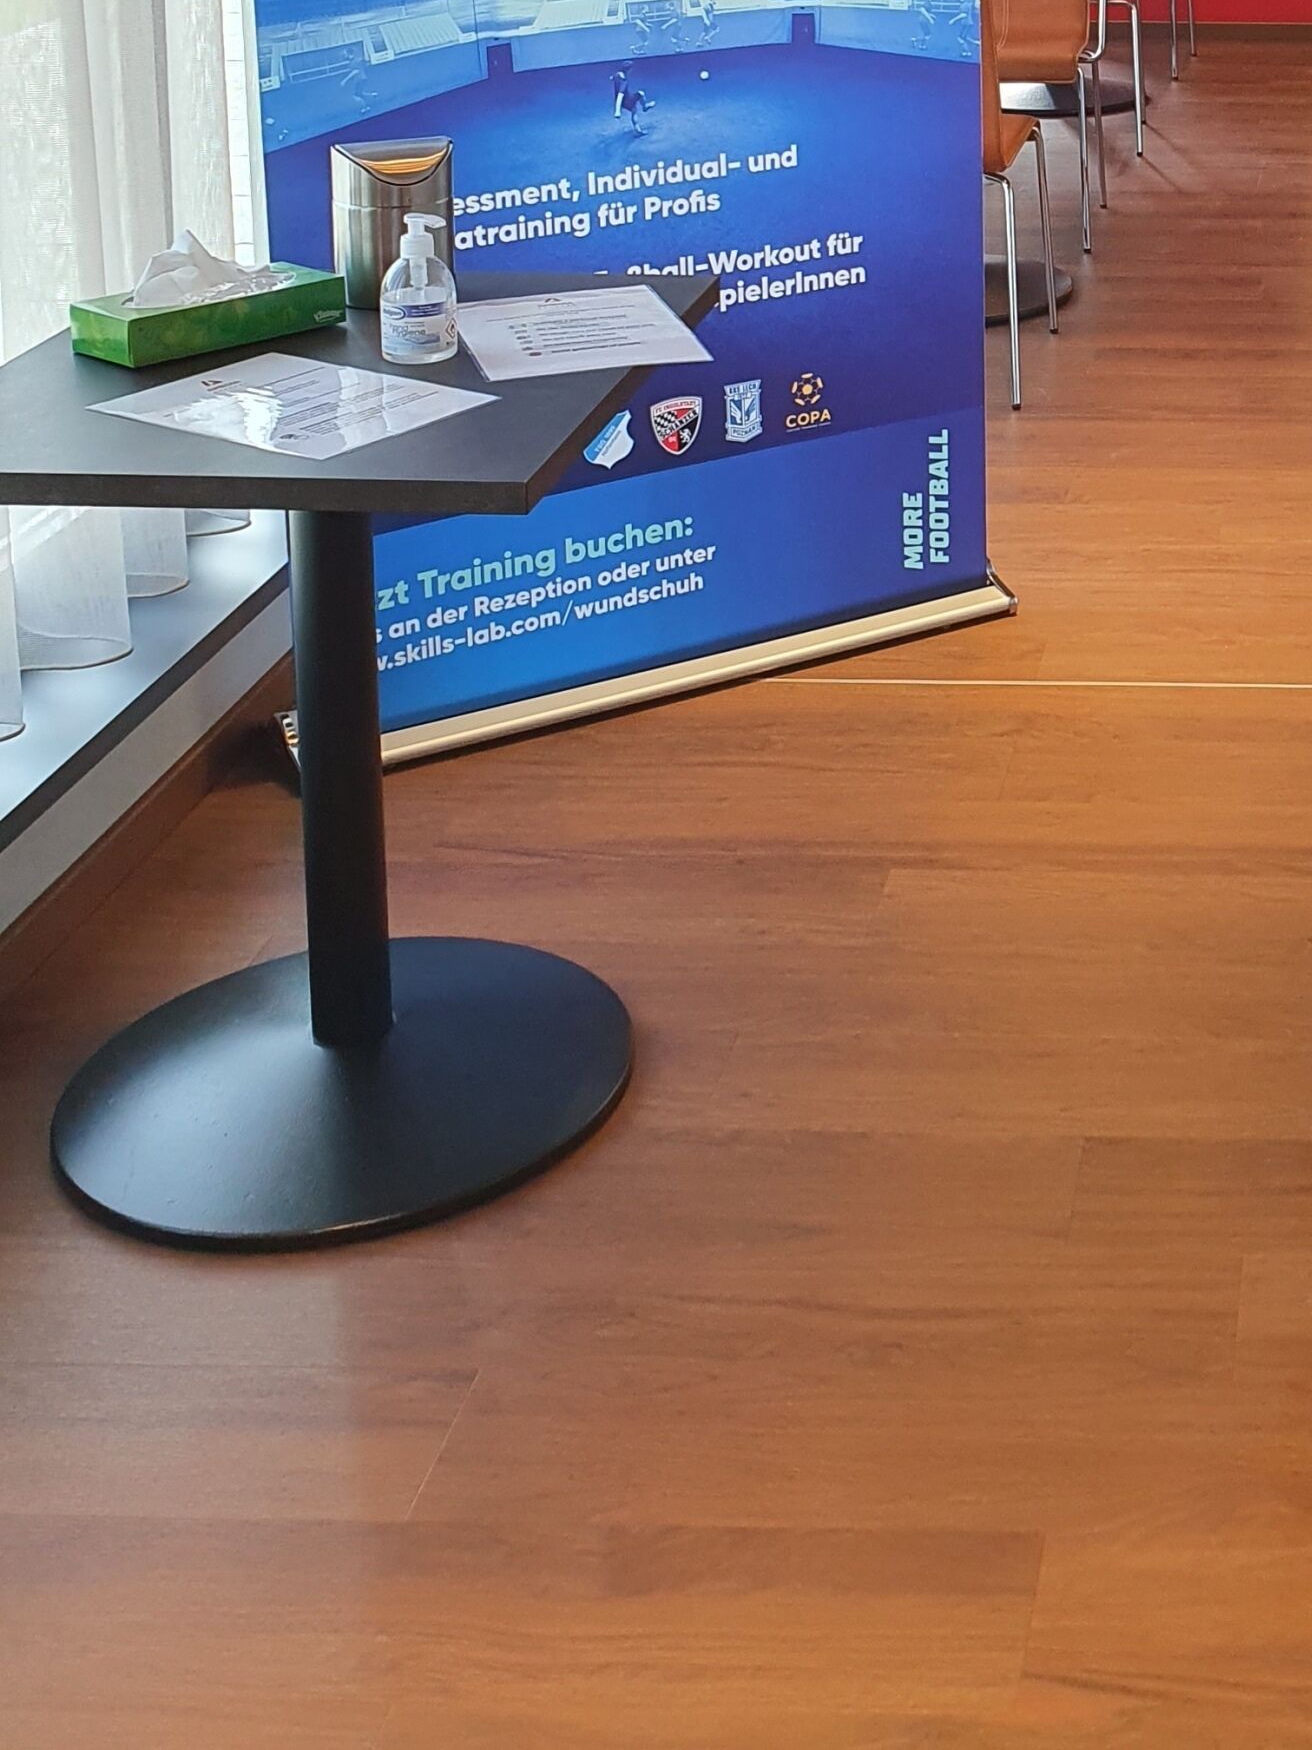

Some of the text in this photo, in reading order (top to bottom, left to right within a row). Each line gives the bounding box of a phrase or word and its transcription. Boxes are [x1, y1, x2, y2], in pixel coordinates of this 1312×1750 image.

[453, 144, 798, 217] essment, Individual- und
[454, 188, 721, 250] atraining für Profis
[826, 232, 864, 257] für
[714, 266, 866, 313] pielerInnen
[786, 408, 831, 428] COPA
[902, 429, 950, 570] MORE FOOTBALL
[388, 618, 421, 639] an
[426, 606, 468, 629] der
[474, 576, 592, 617] Rezeption
[597, 561, 650, 587] oder
[655, 545, 717, 572] unter
[417, 548, 556, 599] Training
[565, 516, 693, 564] buchen:
[377, 572, 704, 671] .skills-lab.com/wundschuh
